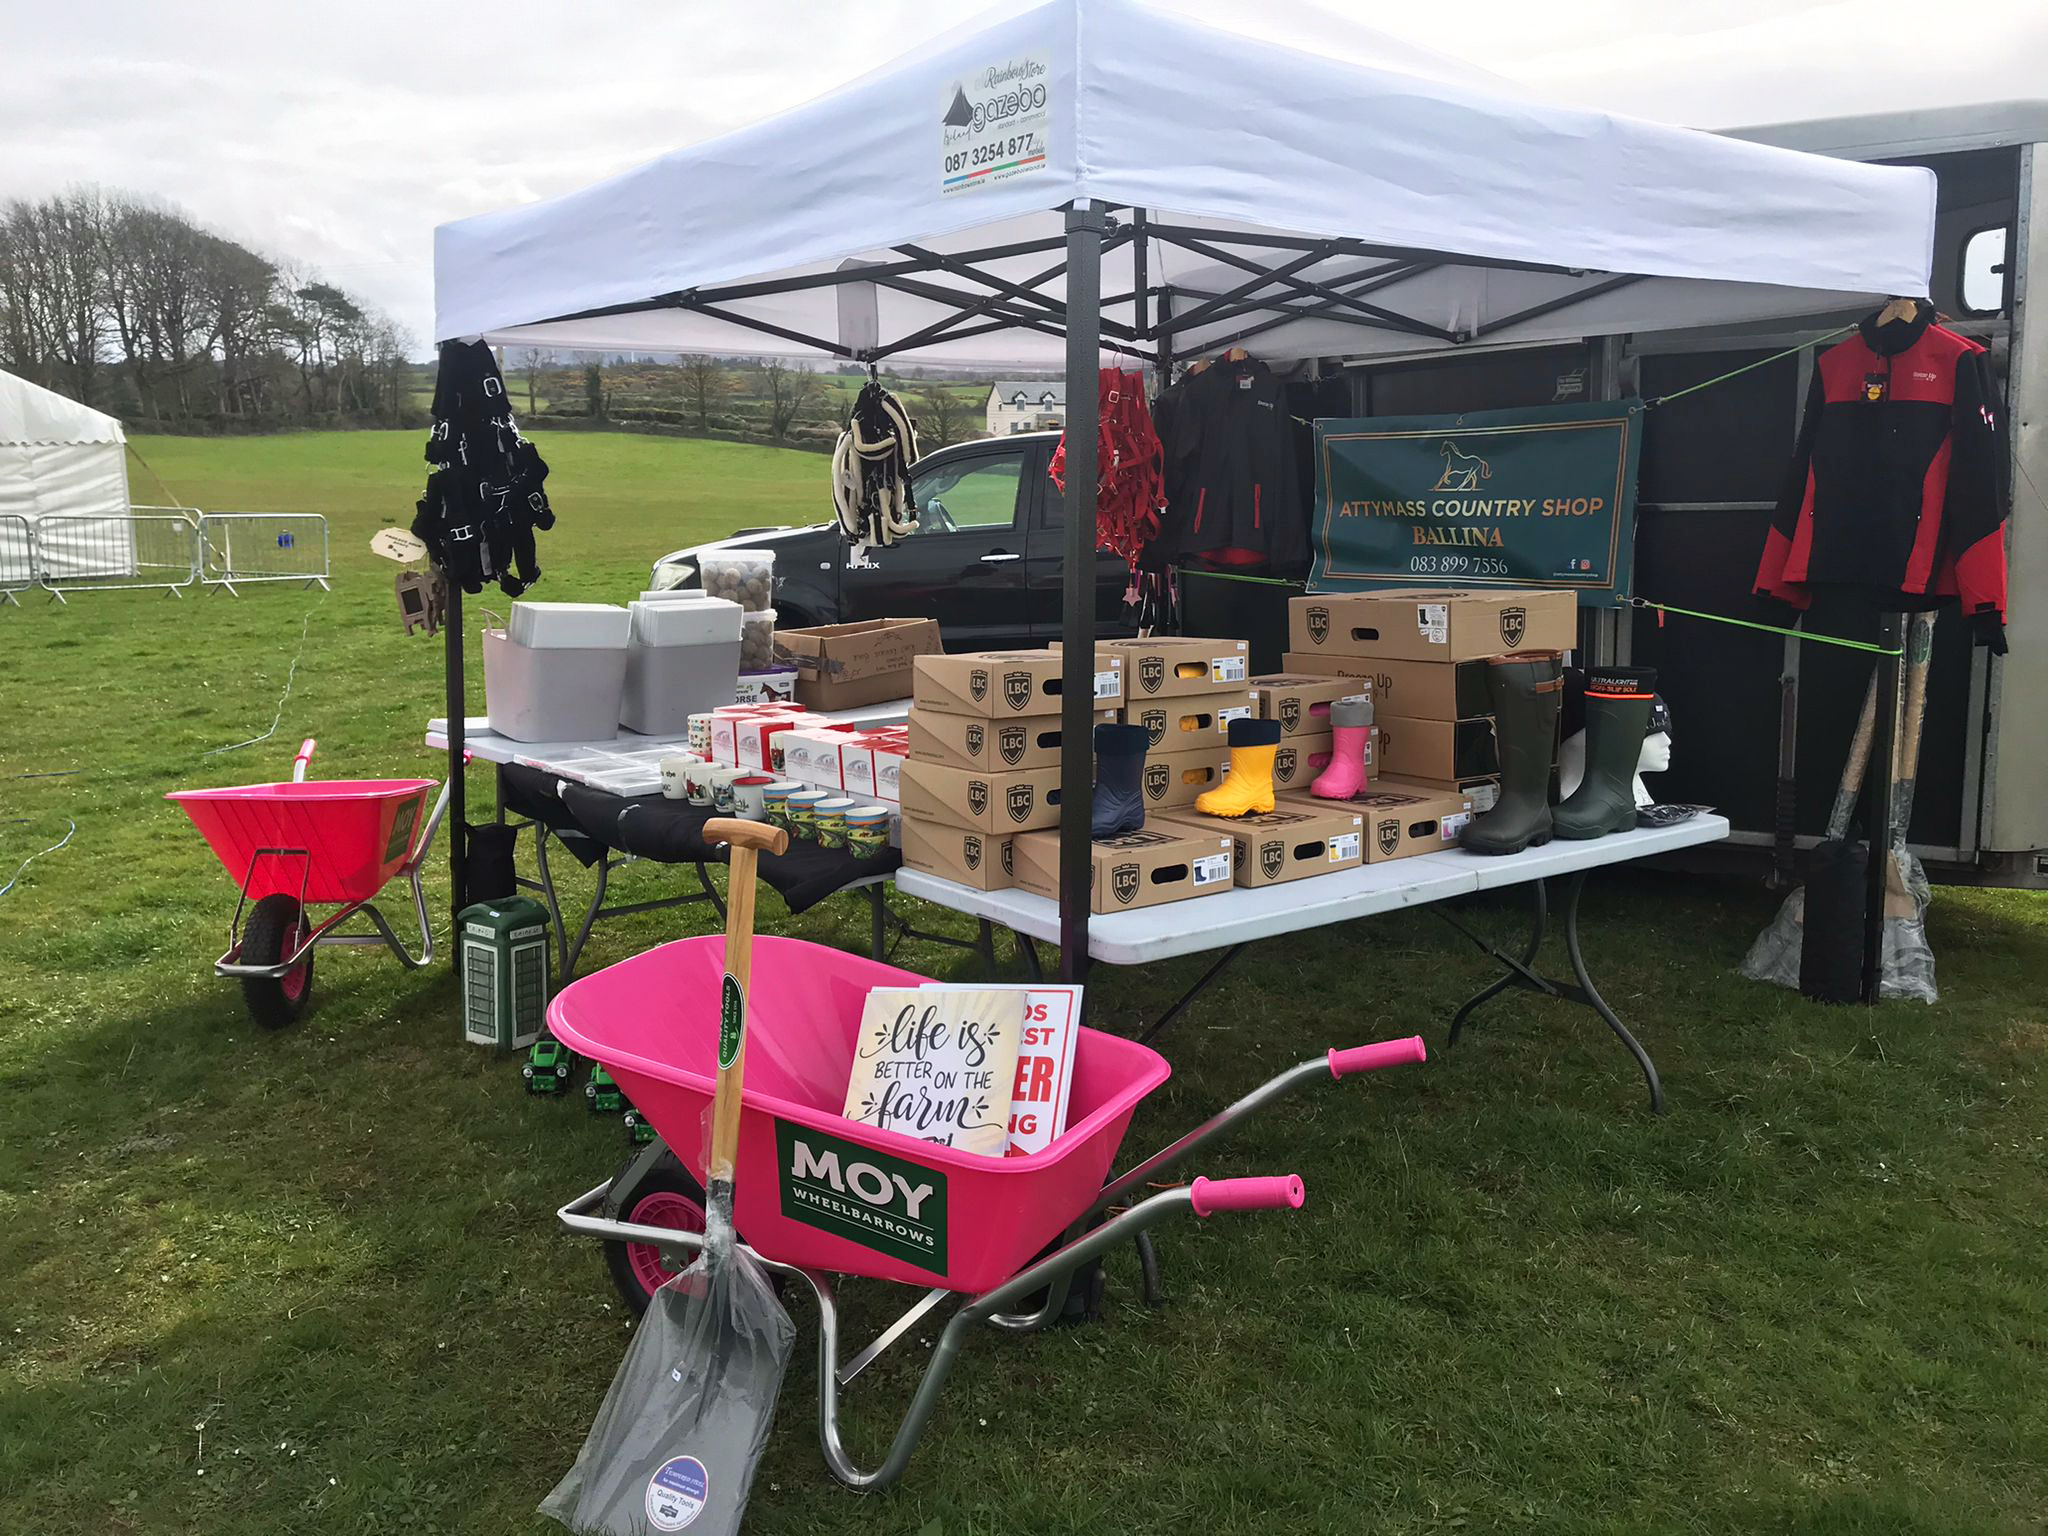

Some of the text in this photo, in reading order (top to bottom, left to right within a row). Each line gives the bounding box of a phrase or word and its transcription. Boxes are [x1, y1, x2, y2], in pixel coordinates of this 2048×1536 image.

[973, 83, 1046, 133] gazebo
[945, 133, 1034, 173] 087 3254 877
[1339, 498, 1604, 518] ATTYMASS COUNTRY SHOP
[1412, 526, 1505, 548] BALLINA
[1410, 556, 1508, 575] 083 899 7556
[1310, 617, 1326, 629] LBC
[1504, 618, 1522, 631] LBC
[1143, 667, 1161, 679] LBC
[973, 678, 985, 689] LBC
[1008, 682, 1028, 695] LBC
[1377, 673, 1392, 699] Up
[1282, 707, 1298, 719] LBC
[968, 733, 981, 744] LBC
[1003, 737, 1022, 749] LBC
[1277, 757, 1294, 769] LBC
[1148, 774, 1166, 785] LBC
[971, 790, 985, 802] LBC
[1011, 795, 1030, 808] LBC
[1381, 828, 1397, 840] LBC
[966, 844, 979, 857] LBC
[1264, 851, 1280, 864] LBC
[1116, 874, 1136, 888] LBC
[860, 1004, 986, 1067] life is
[1020, 1028, 1055, 1046] ST
[874, 1061, 994, 1089] BETTER ON THE
[850, 1080, 1003, 1131] farm
[791, 1140, 934, 1220] MOY
[792, 1187, 935, 1247] WHEELBARROWS
[657, 1489, 695, 1509] Quality Tools
